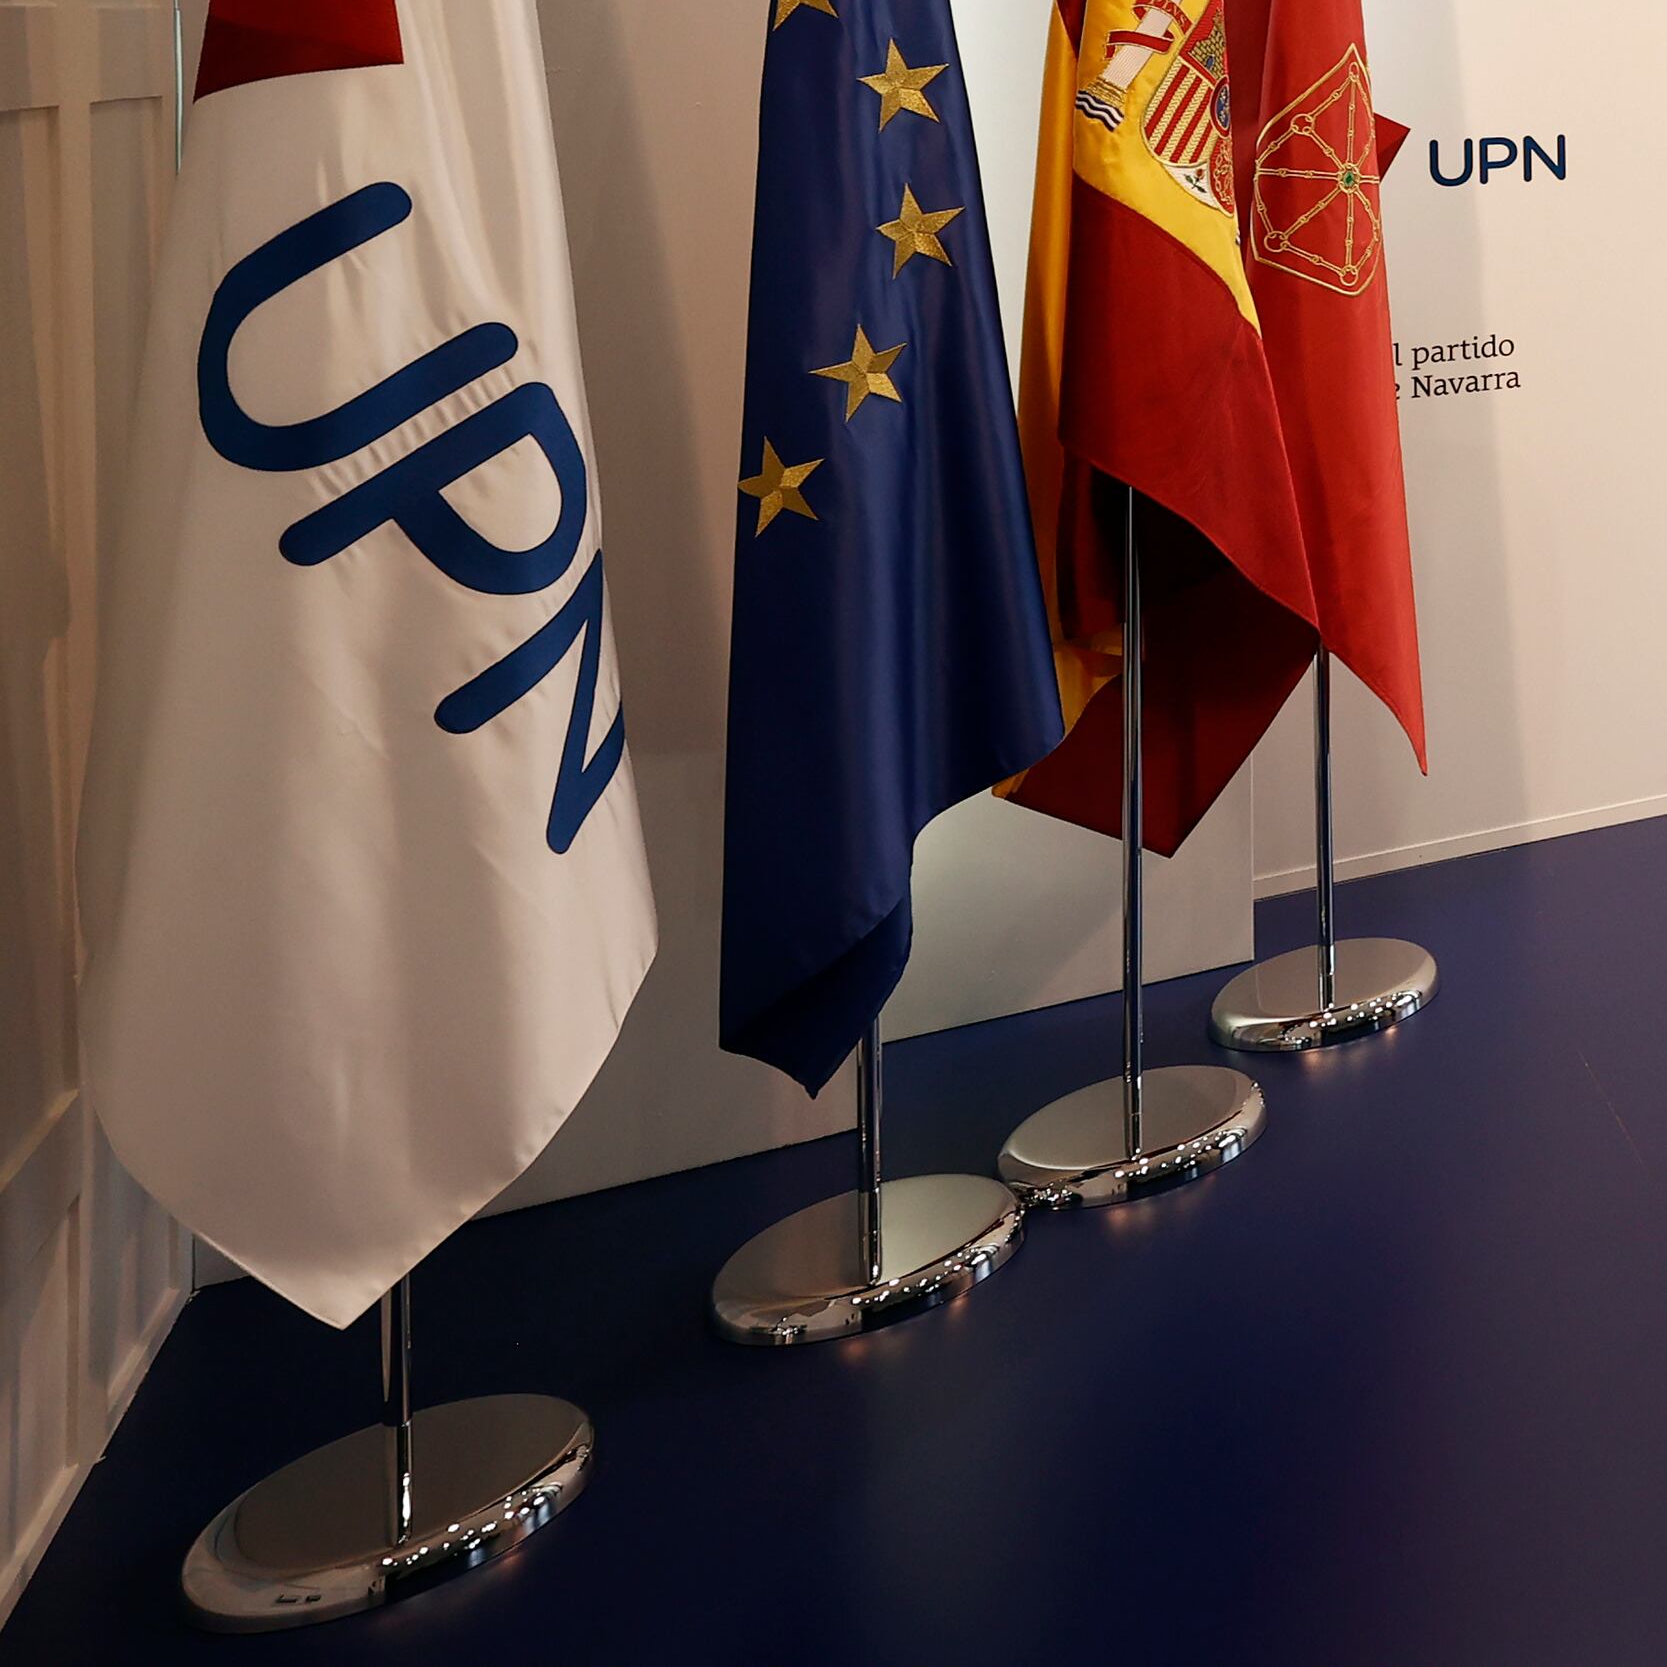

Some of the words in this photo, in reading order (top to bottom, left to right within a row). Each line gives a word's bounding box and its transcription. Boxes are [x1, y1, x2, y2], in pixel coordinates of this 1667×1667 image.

[1429, 135, 1566, 186] UPN
[1411, 335, 1514, 370] partido
[1411, 372, 1520, 398] Navarra
[197, 181, 625, 854] UPN
